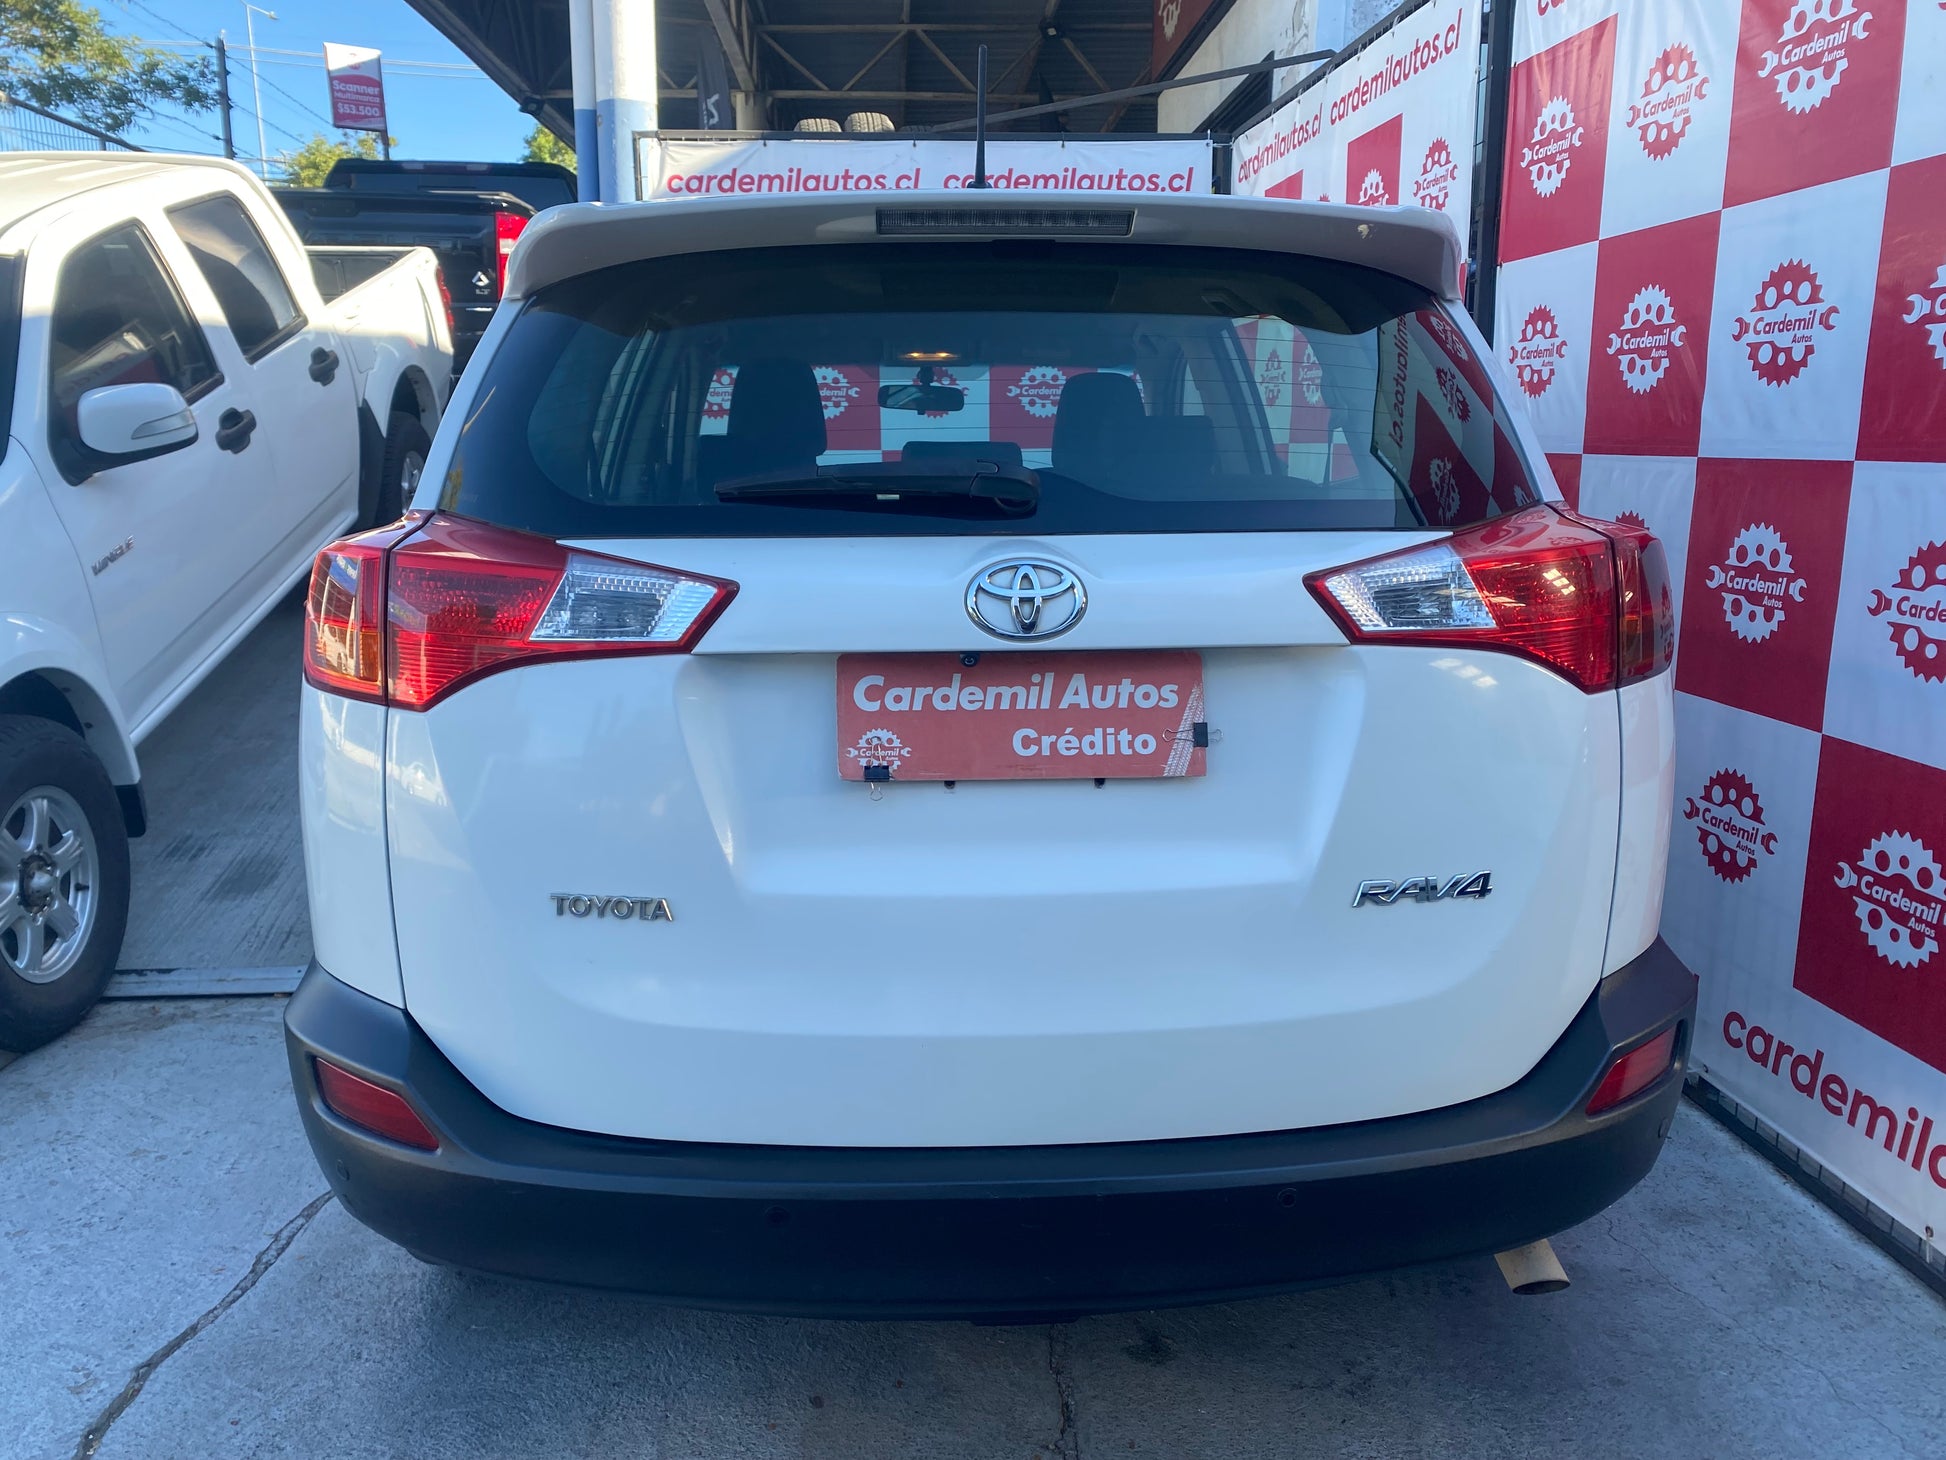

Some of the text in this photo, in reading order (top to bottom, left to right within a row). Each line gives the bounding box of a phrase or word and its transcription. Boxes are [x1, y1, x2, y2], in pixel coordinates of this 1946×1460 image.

[1781, 21, 1850, 66] Cardemil
[1330, 7, 1463, 126] cardemilautos.cl
[1822, 48, 1846, 64] Autos
[333, 80, 379, 94] Scanner
[337, 103, 380, 116] $53.500
[1642, 89, 1692, 120] Cardemil
[1672, 107, 1690, 120] Autos
[1237, 103, 1323, 184] cardemilautos.cl
[1532, 136, 1571, 160] Cardemil
[1555, 151, 1570, 163] Autos
[666, 167, 921, 194] cardemilautos.cl
[1422, 168, 1450, 191] Cardemil
[1753, 315, 1816, 336] Cardemil
[1622, 331, 1670, 349] Cardemil
[1791, 334, 1813, 344] Autos
[1519, 345, 1556, 360] Cardemil
[1650, 349, 1668, 358] Autos
[820, 387, 847, 396] demil
[1727, 570, 1787, 597] Cardemil
[1762, 597, 1783, 609] Autos
[1896, 596, 1946, 623] Carde
[853, 672, 1179, 712] Cardemil Autos
[1012, 728, 1157, 757] Crédito
[1702, 807, 1760, 846] Cardemil
[1735, 839, 1756, 857] Autos
[1352, 870, 1493, 908] RAV4
[1861, 874, 1941, 925] Cardemil
[549, 893, 674, 921] TOYOTA
[1908, 916, 1936, 938] Autos
